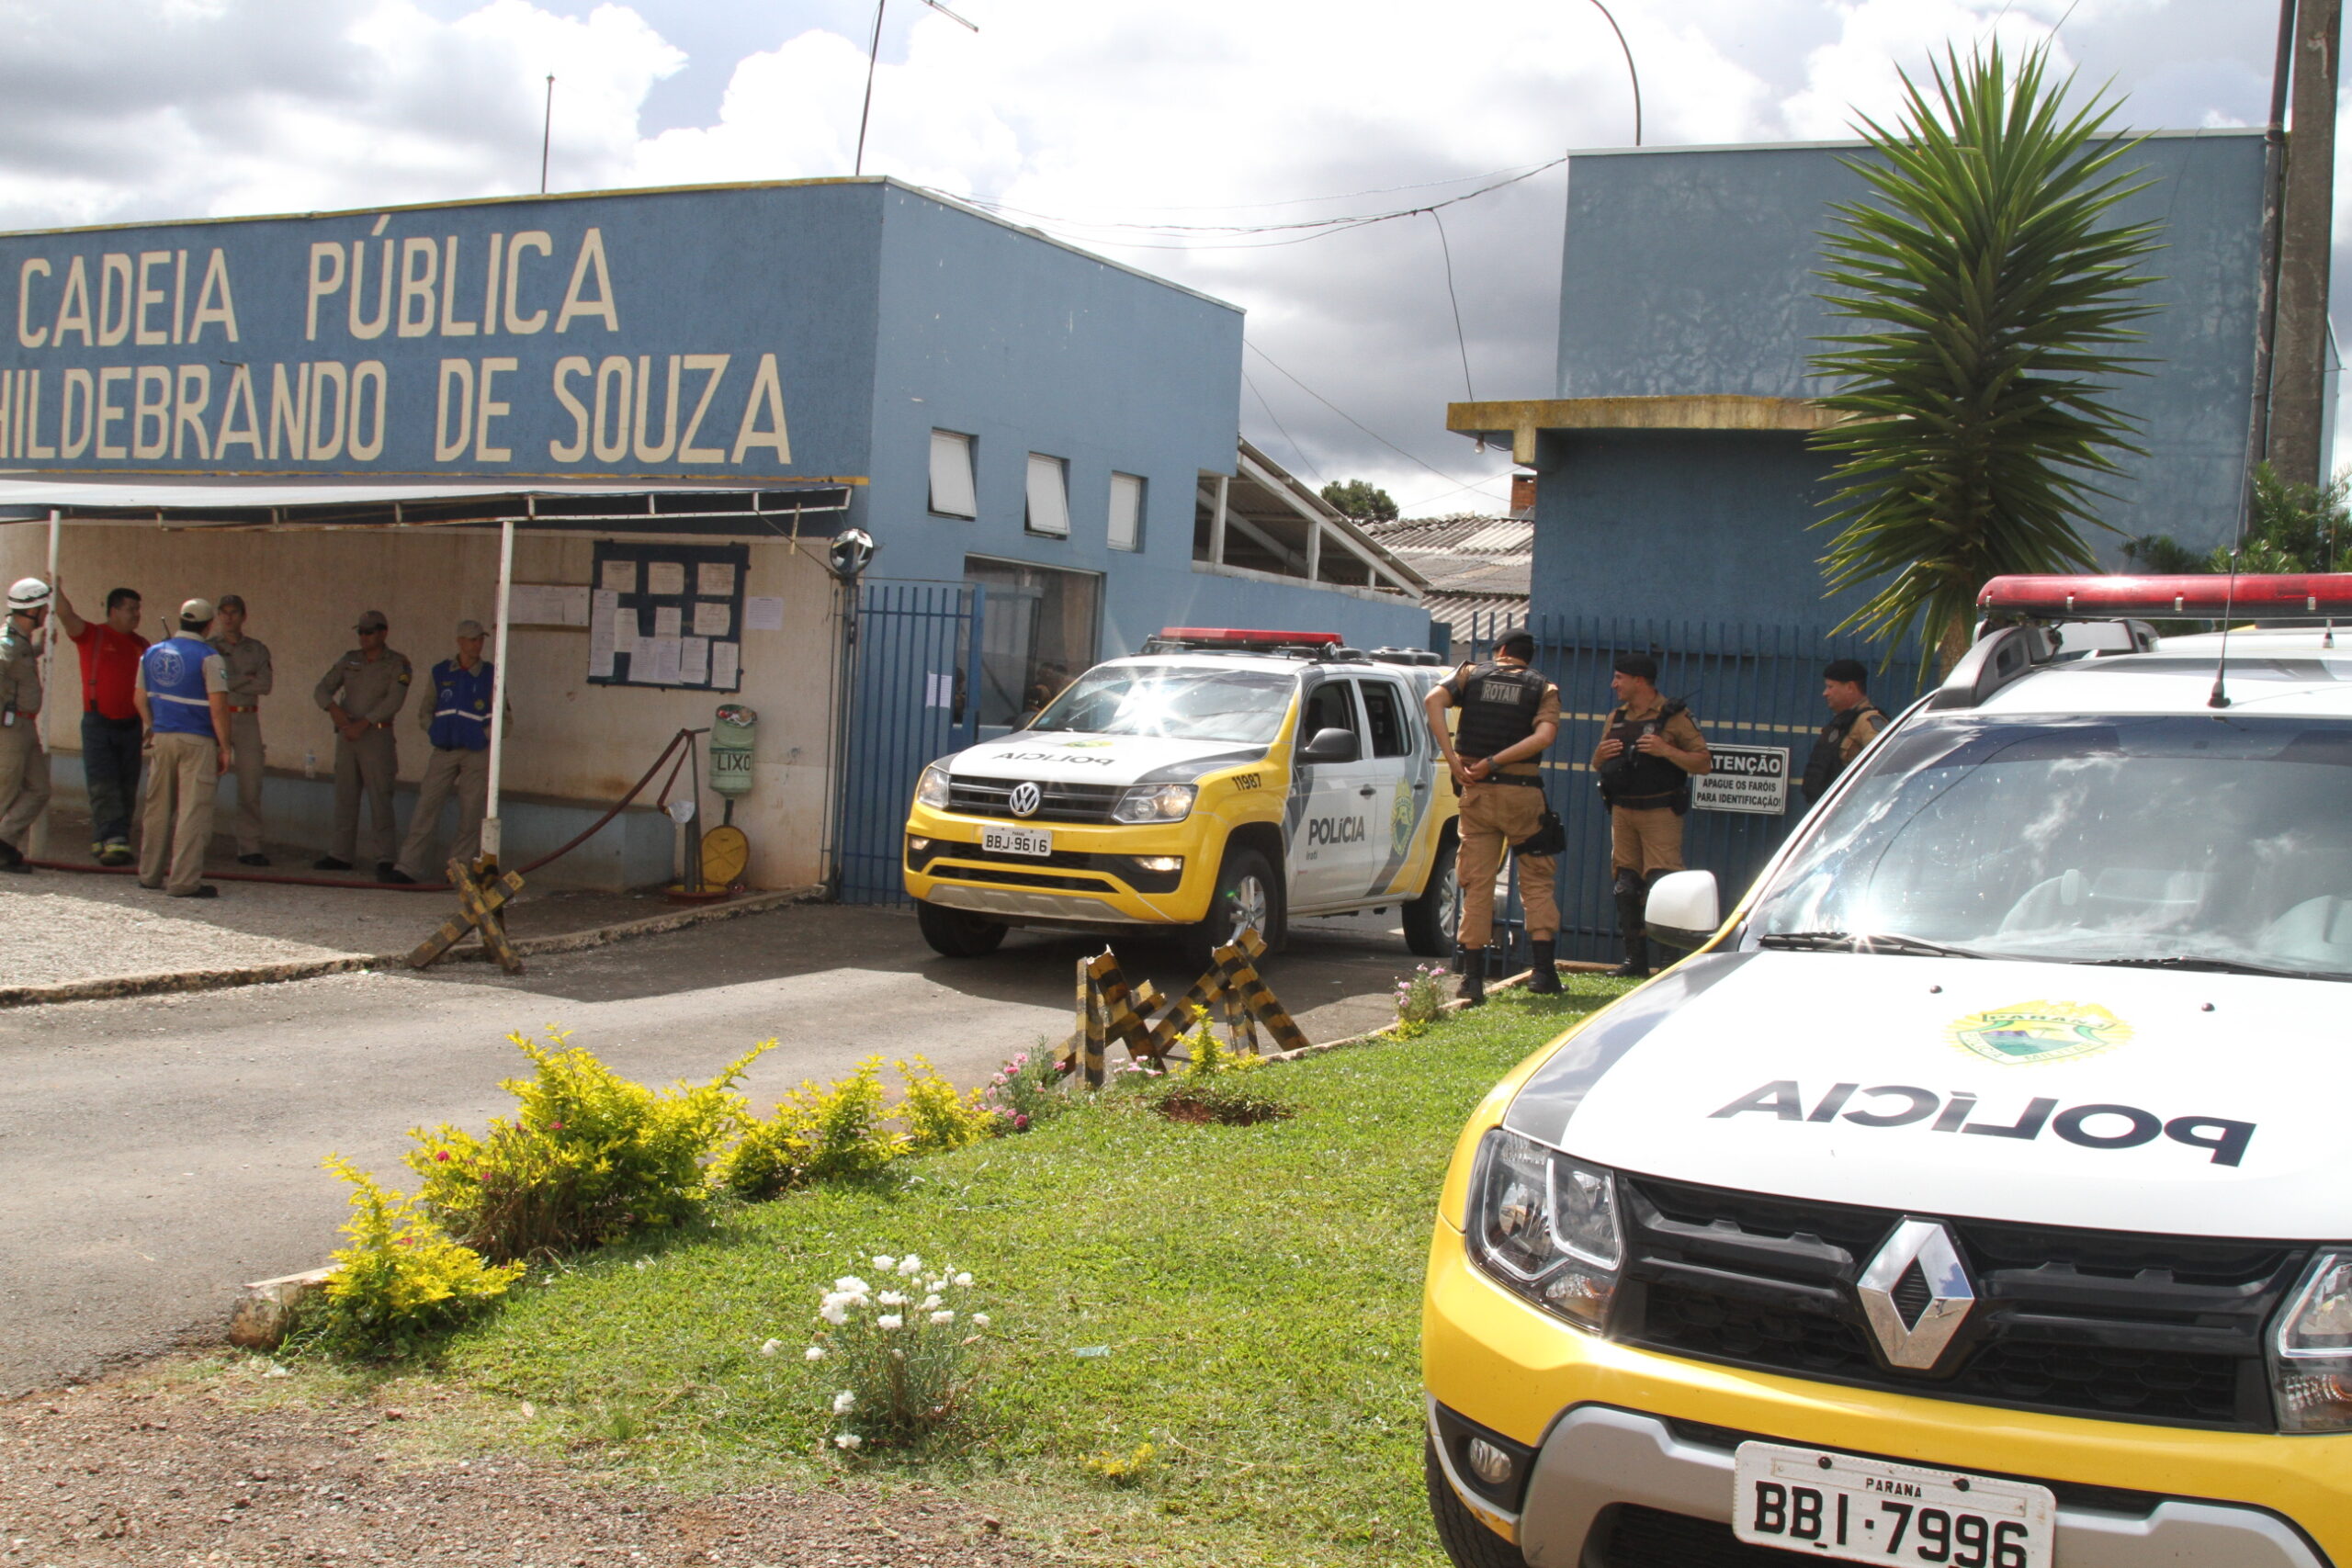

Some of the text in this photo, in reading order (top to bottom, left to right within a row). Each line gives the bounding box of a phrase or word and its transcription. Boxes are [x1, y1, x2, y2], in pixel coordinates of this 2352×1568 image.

[18, 215, 619, 348] CADEIA PÚBLICA
[435, 357, 518, 462] DE
[550, 354, 792, 464] SOUZA
[1483, 682, 1521, 703] ROTAM
[718, 754, 752, 772] LIXO
[1710, 755, 1781, 775] TENÇÃO
[1232, 773, 1262, 792] 11987
[1702, 778, 1777, 793] APAGUE OS FARÓIS
[1697, 792, 1717, 803] PARA
